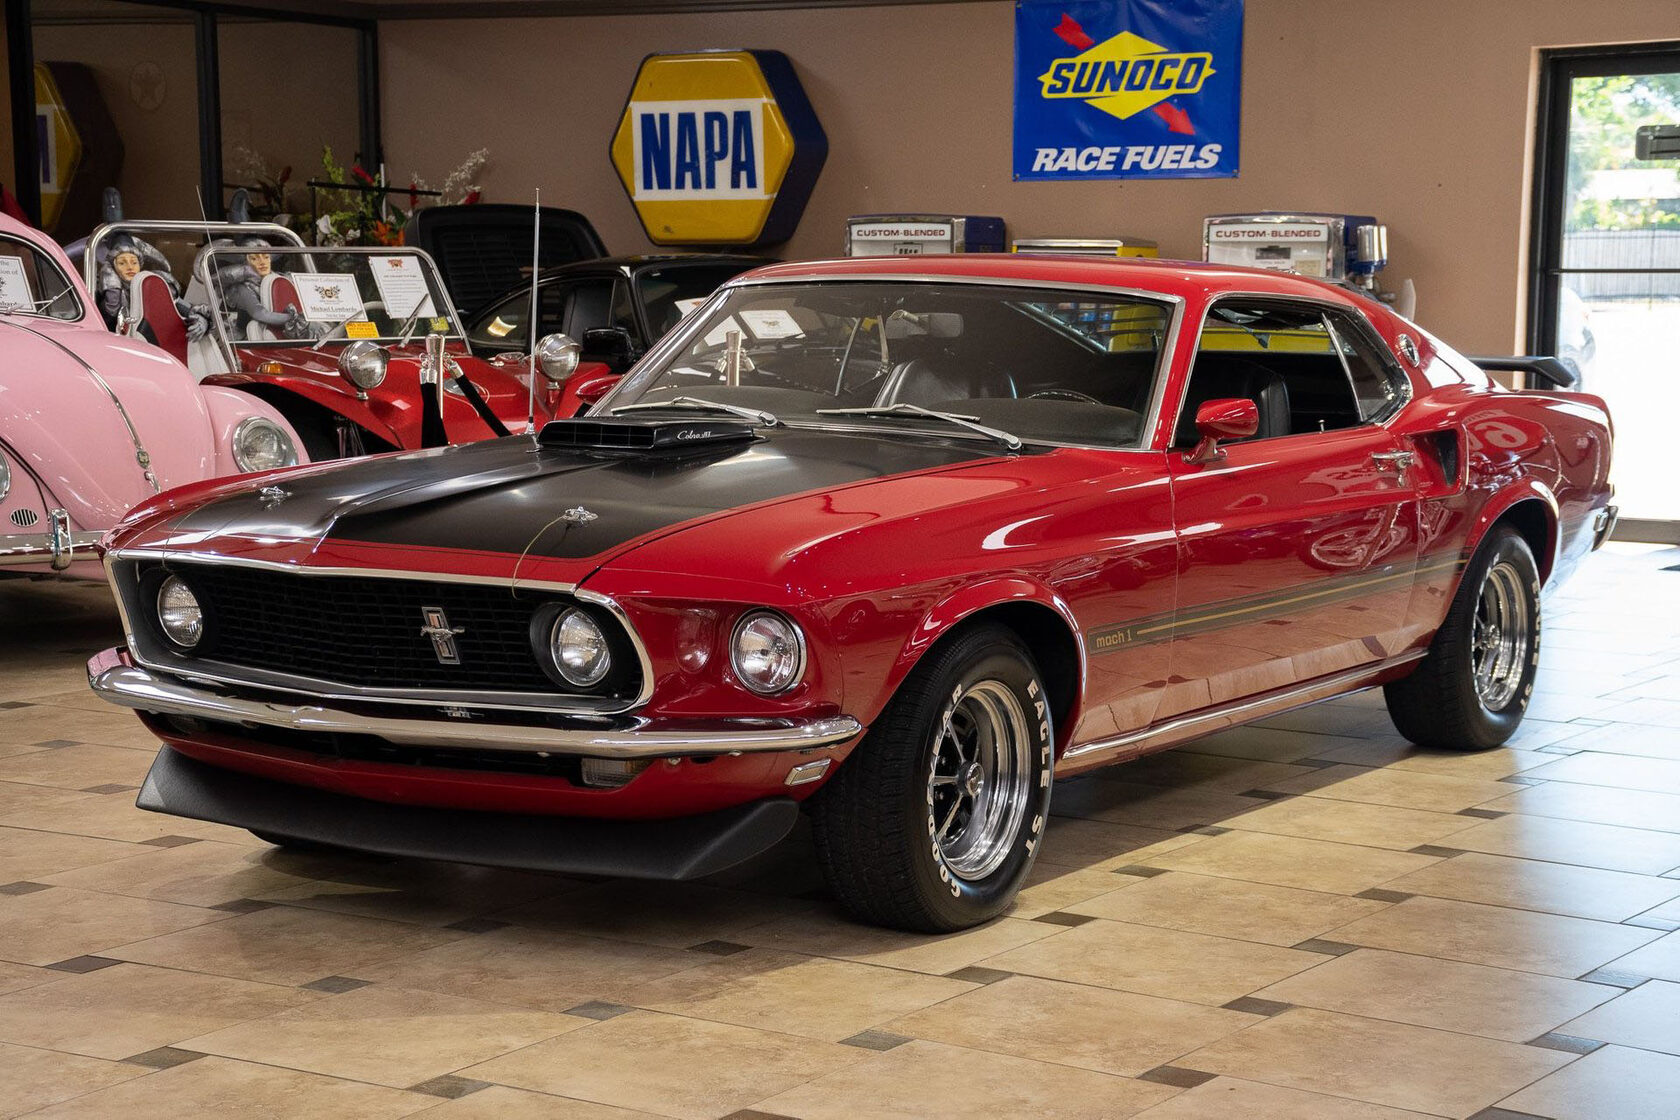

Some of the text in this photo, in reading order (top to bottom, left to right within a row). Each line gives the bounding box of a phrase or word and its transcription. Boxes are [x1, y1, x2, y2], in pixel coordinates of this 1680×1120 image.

[1046, 57, 1208, 94] SUNOCO
[640, 110, 757, 190] NAPA
[1032, 144, 1222, 172] RACE FUELS
[856, 229, 946, 237] CUSTOM-BLENDED
[1215, 229, 1321, 238] CUSTOM-BLENDED
[1096, 629, 1133, 648] mach 1
[1025, 679, 1050, 858] EAGLE ST
